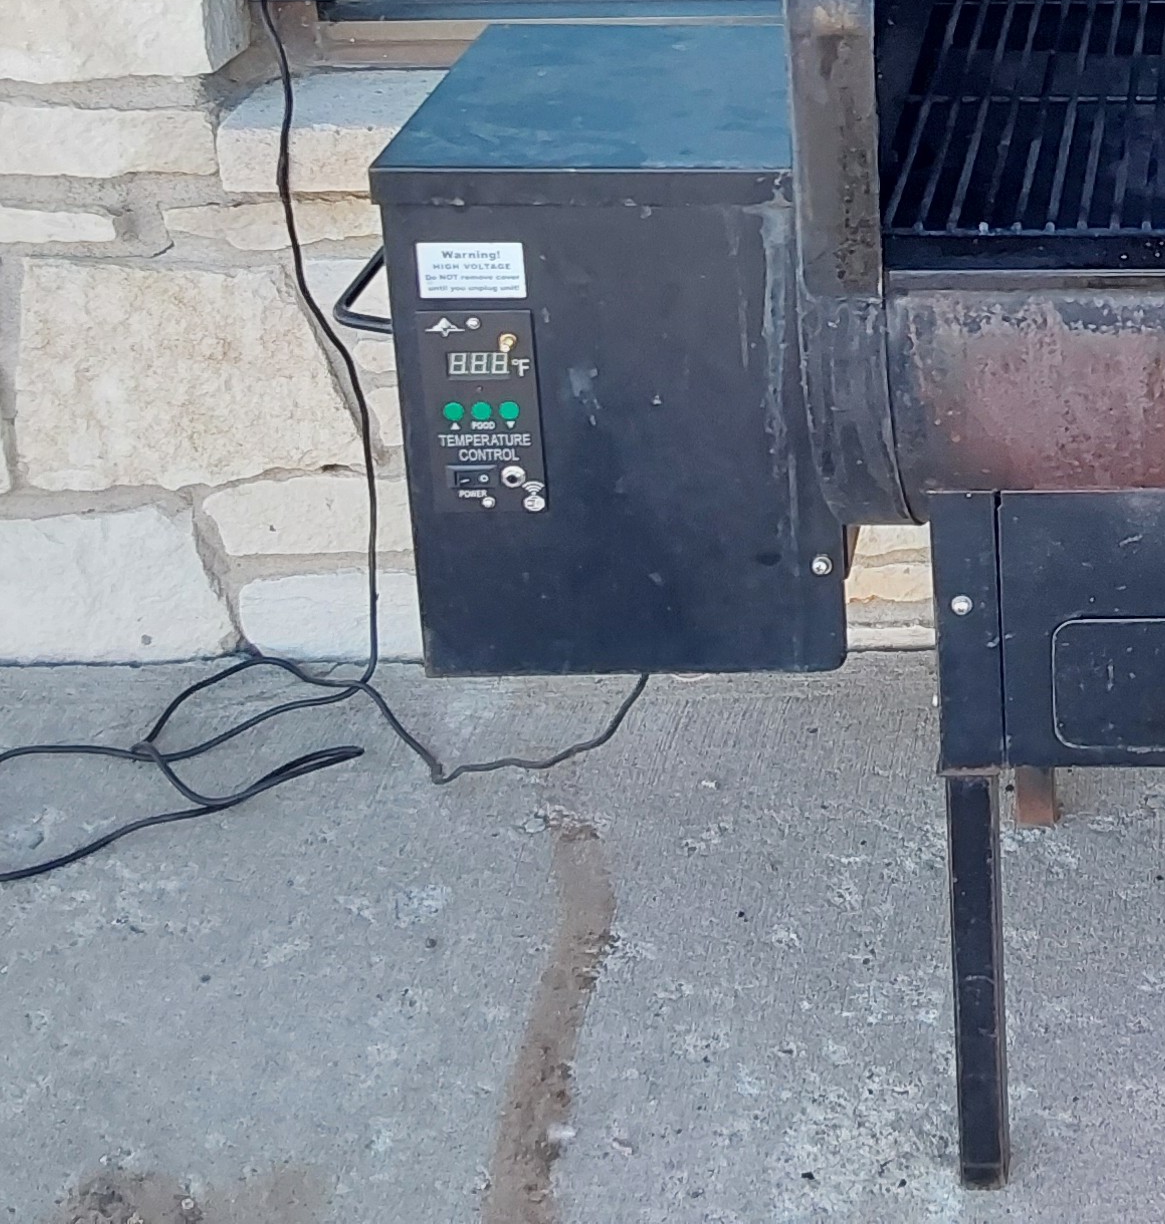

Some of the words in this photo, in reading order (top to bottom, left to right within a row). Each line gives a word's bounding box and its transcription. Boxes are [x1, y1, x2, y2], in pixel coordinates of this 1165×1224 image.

[441, 250, 500, 261] Warning!
[438, 434, 532, 447] TEMPERATURE
[458, 449, 520, 461] CONTROL
[458, 490, 487, 498] POWER
